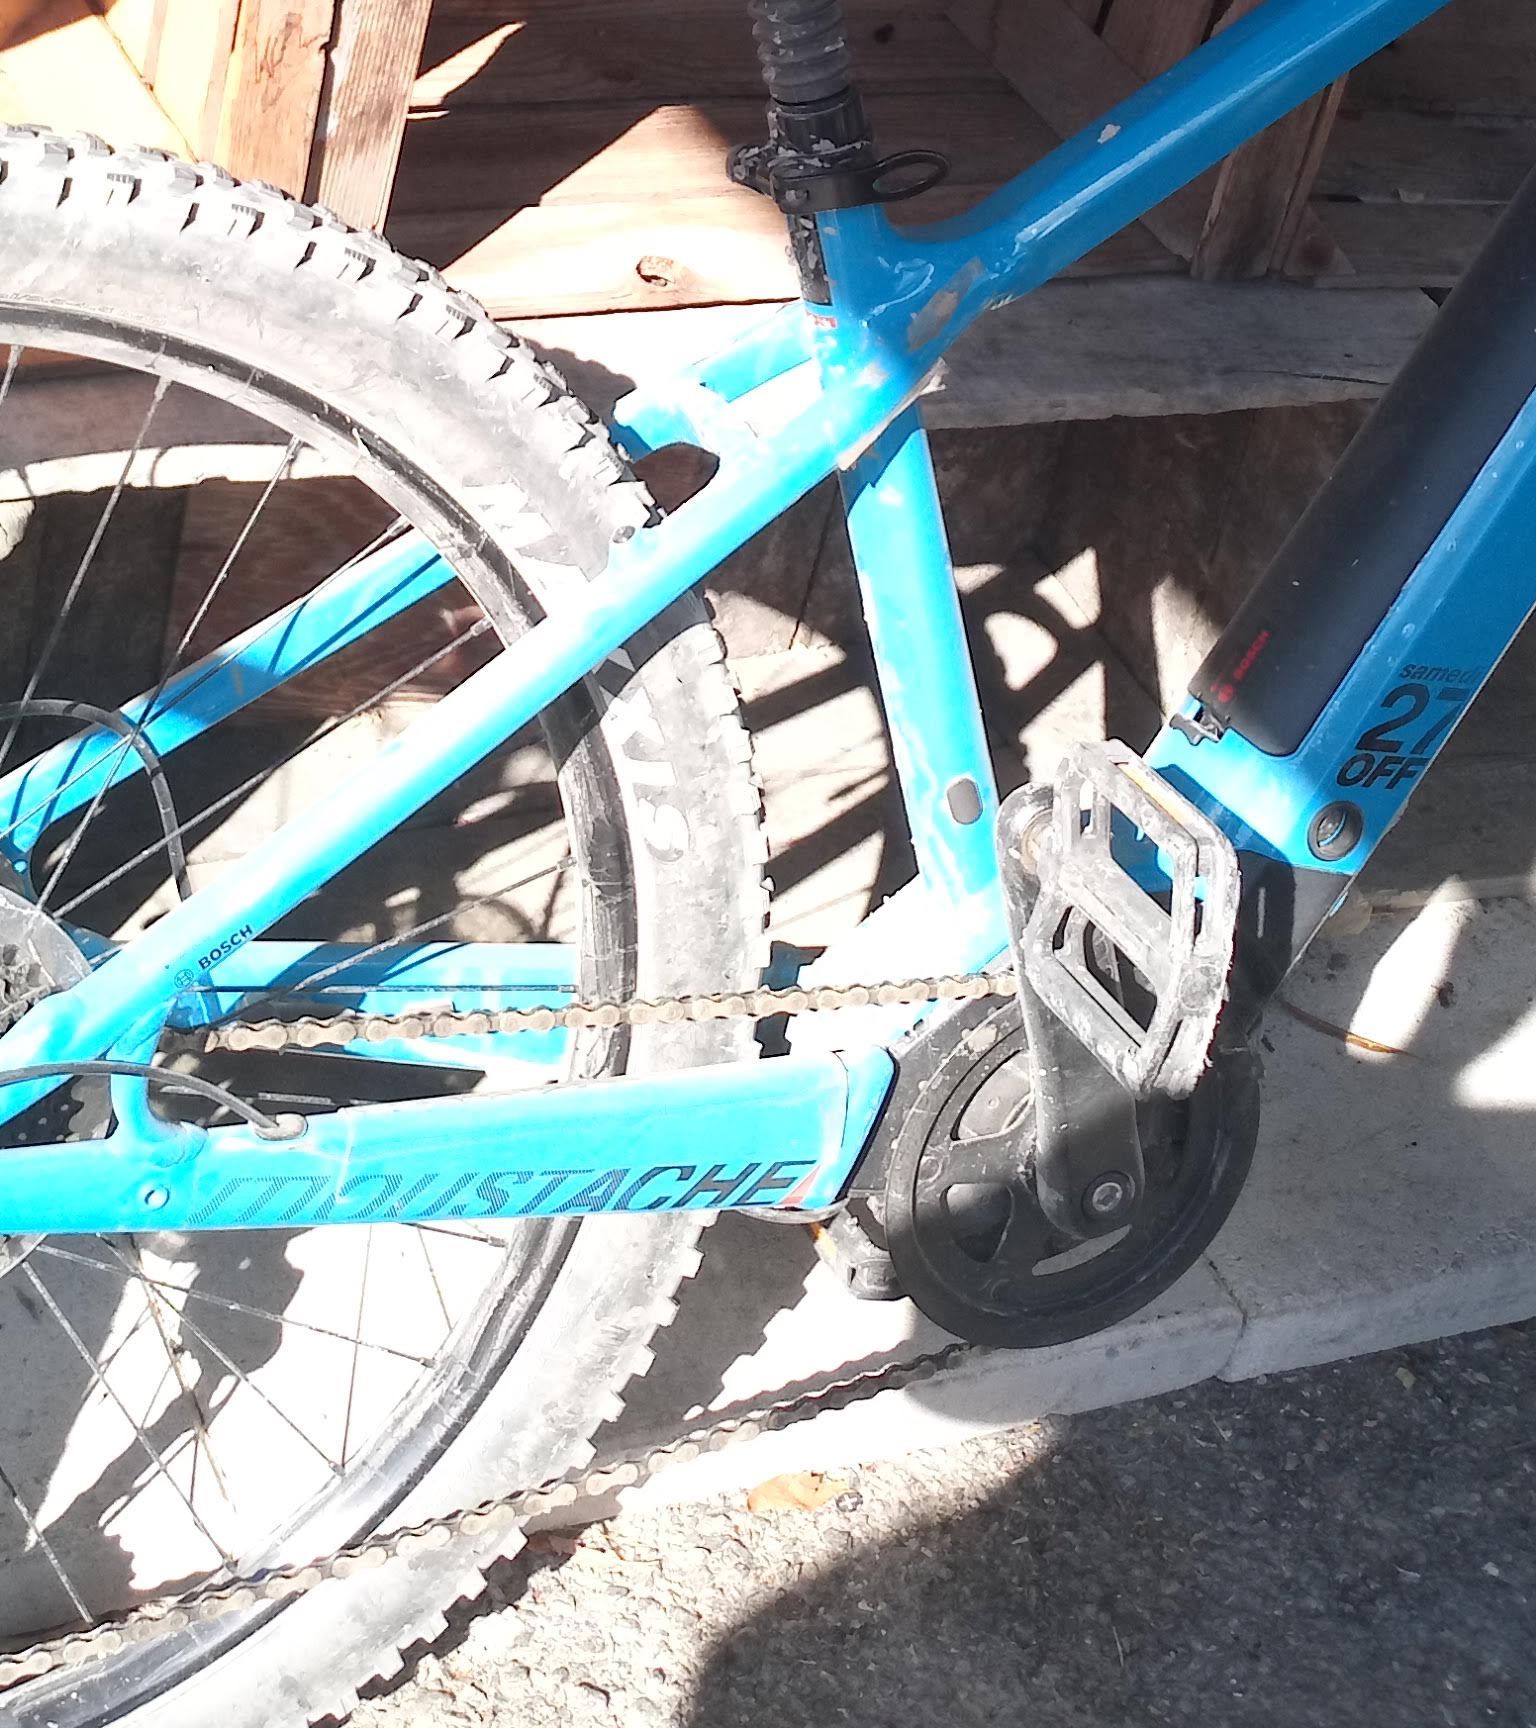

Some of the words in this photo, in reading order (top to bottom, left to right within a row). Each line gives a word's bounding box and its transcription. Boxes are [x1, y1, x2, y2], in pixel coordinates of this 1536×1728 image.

[1355, 683, 1472, 754] 27
[1336, 753, 1431, 789] OFF
[198, 924, 254, 970] BOSCH
[184, 1160, 817, 1223] MOUSTACHE
